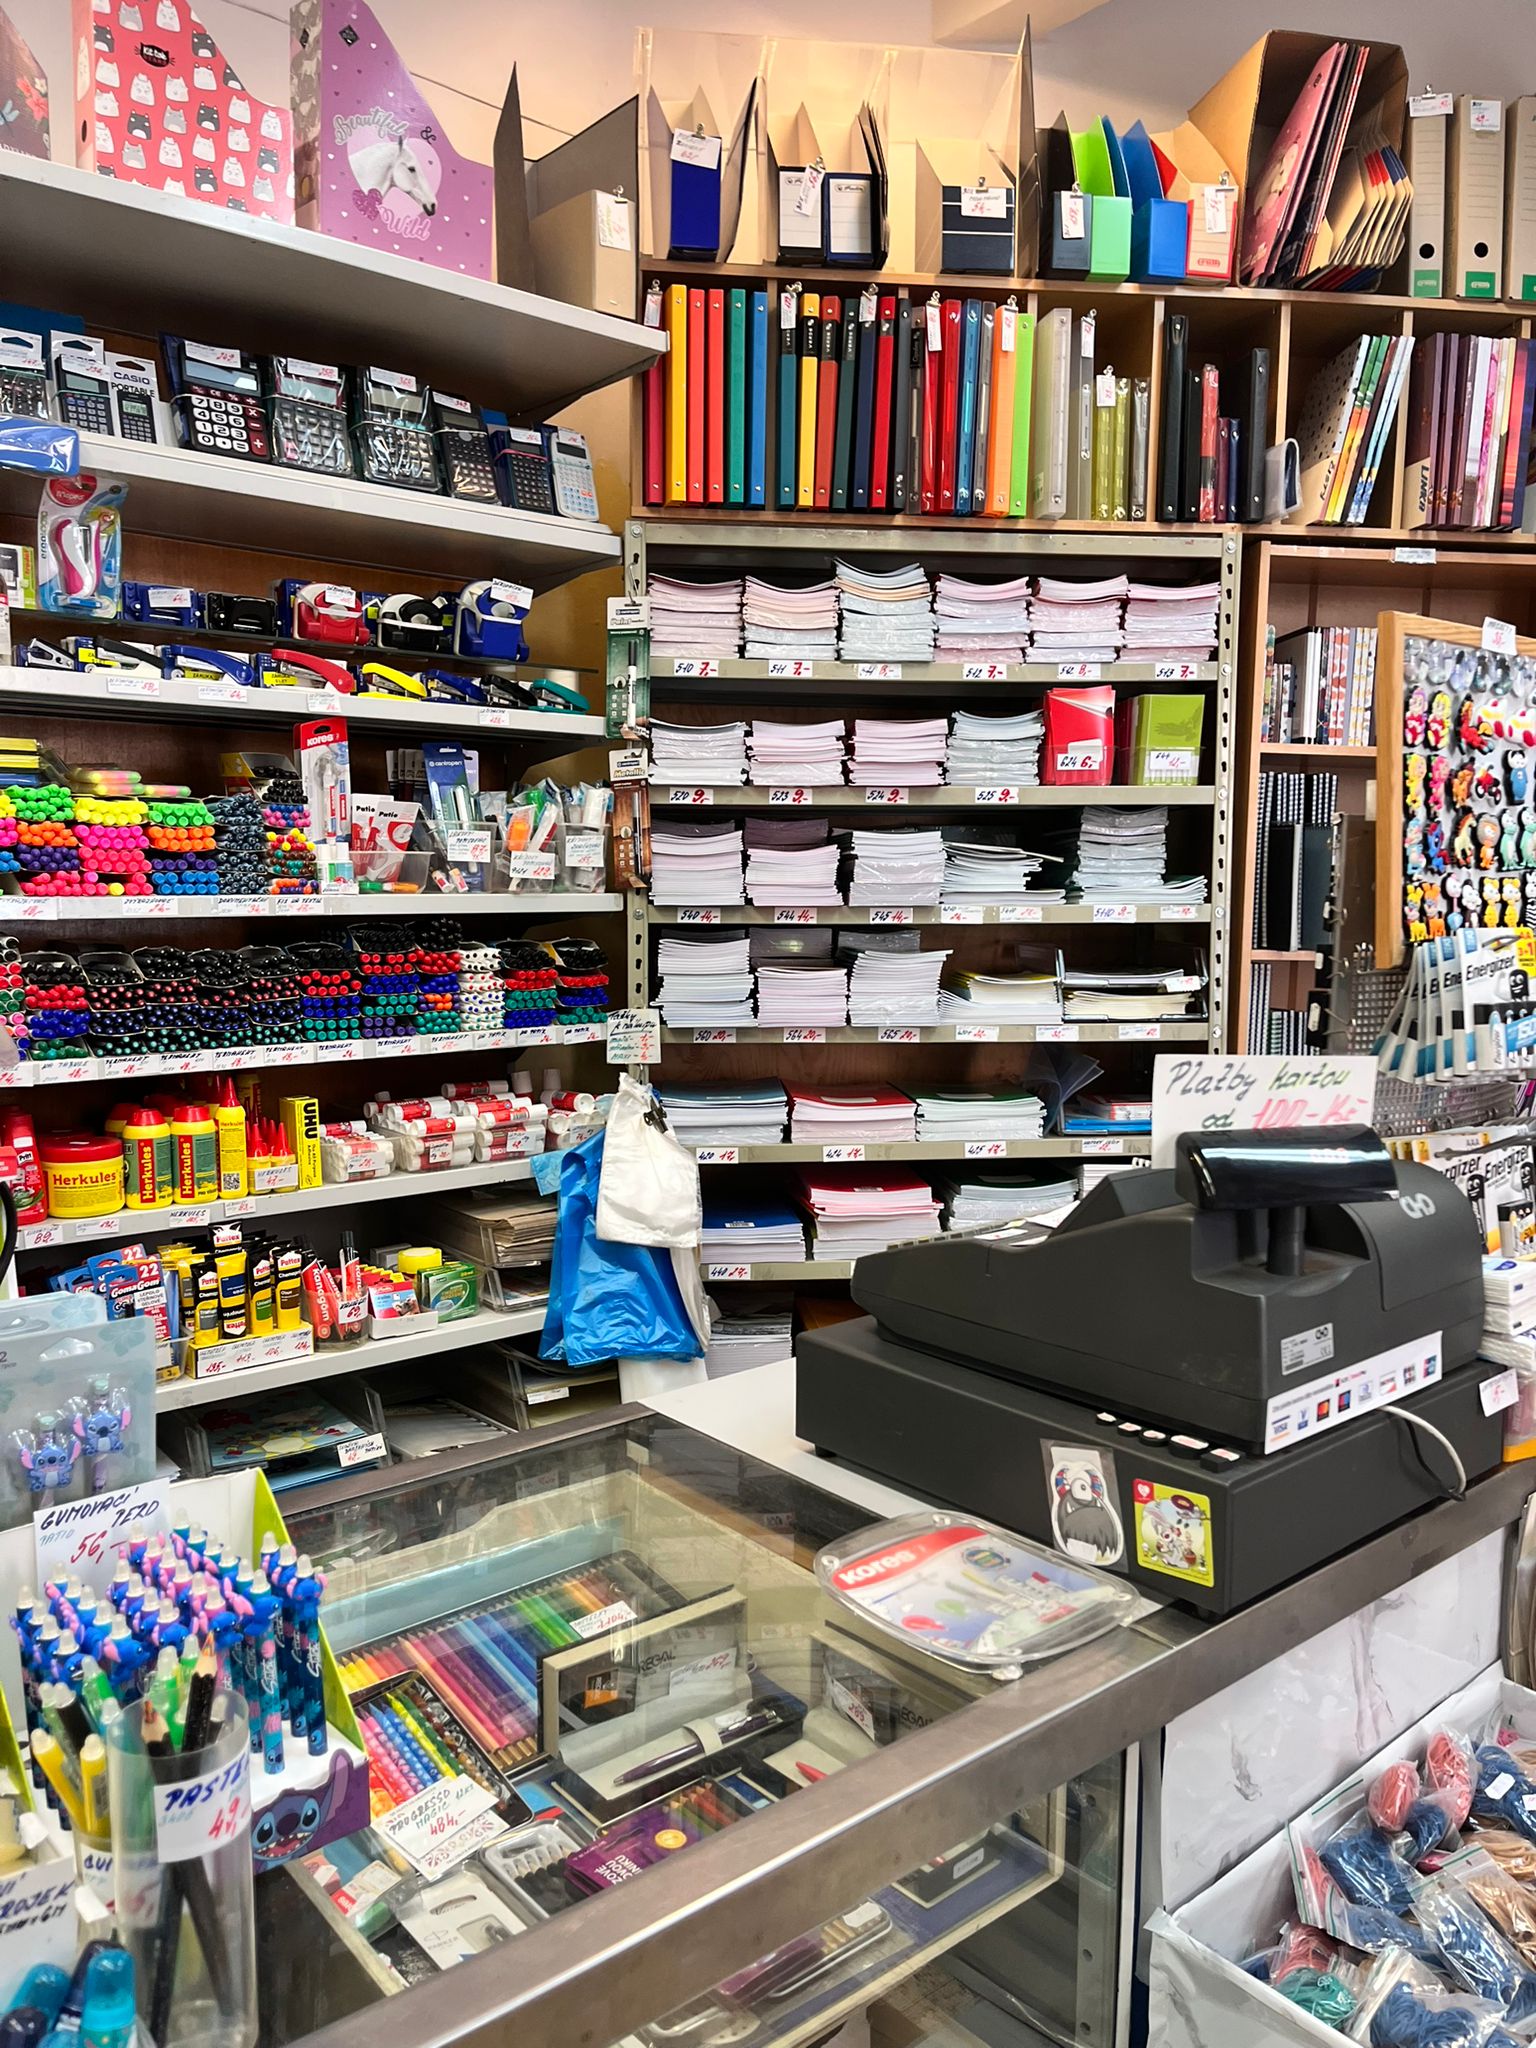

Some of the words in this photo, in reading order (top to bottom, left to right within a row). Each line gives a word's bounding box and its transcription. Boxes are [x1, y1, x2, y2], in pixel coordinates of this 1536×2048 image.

[333, 105, 407, 145] Beautiful
[421, 125, 437, 144] &
[381, 209, 431, 241] Wild
[111, 382, 155, 398] PORTABLE
[114, 371, 150, 385] CASIO
[356, 805, 375, 813] Patio
[378, 810, 398, 818] Patio
[1466, 956, 1515, 981] Energizer
[1166, 1060, 1257, 1102] Platby
[1268, 1061, 1351, 1091] kartou
[303, 1102, 318, 1139] UHU
[1202, 1108, 1236, 1129] od
[142, 1146, 154, 1200] Herkules
[183, 1142, 193, 1196] Herkules
[1484, 1147, 1529, 1181] Energizer
[53, 1172, 116, 1187] Herkules
[124, 1246, 144, 1261] 22
[281, 1257, 302, 1267] Pattex
[140, 1264, 159, 1278] 22
[111, 1278, 160, 1299] GomaGom
[41, 1486, 140, 1531] GUMOVACÍ
[70, 1530, 128, 1564] 56,-
[639, 1650, 676, 1673] REGAL
[389, 1789, 452, 1834] PROGRESSO
[415, 1802, 449, 1828] MAGIC
